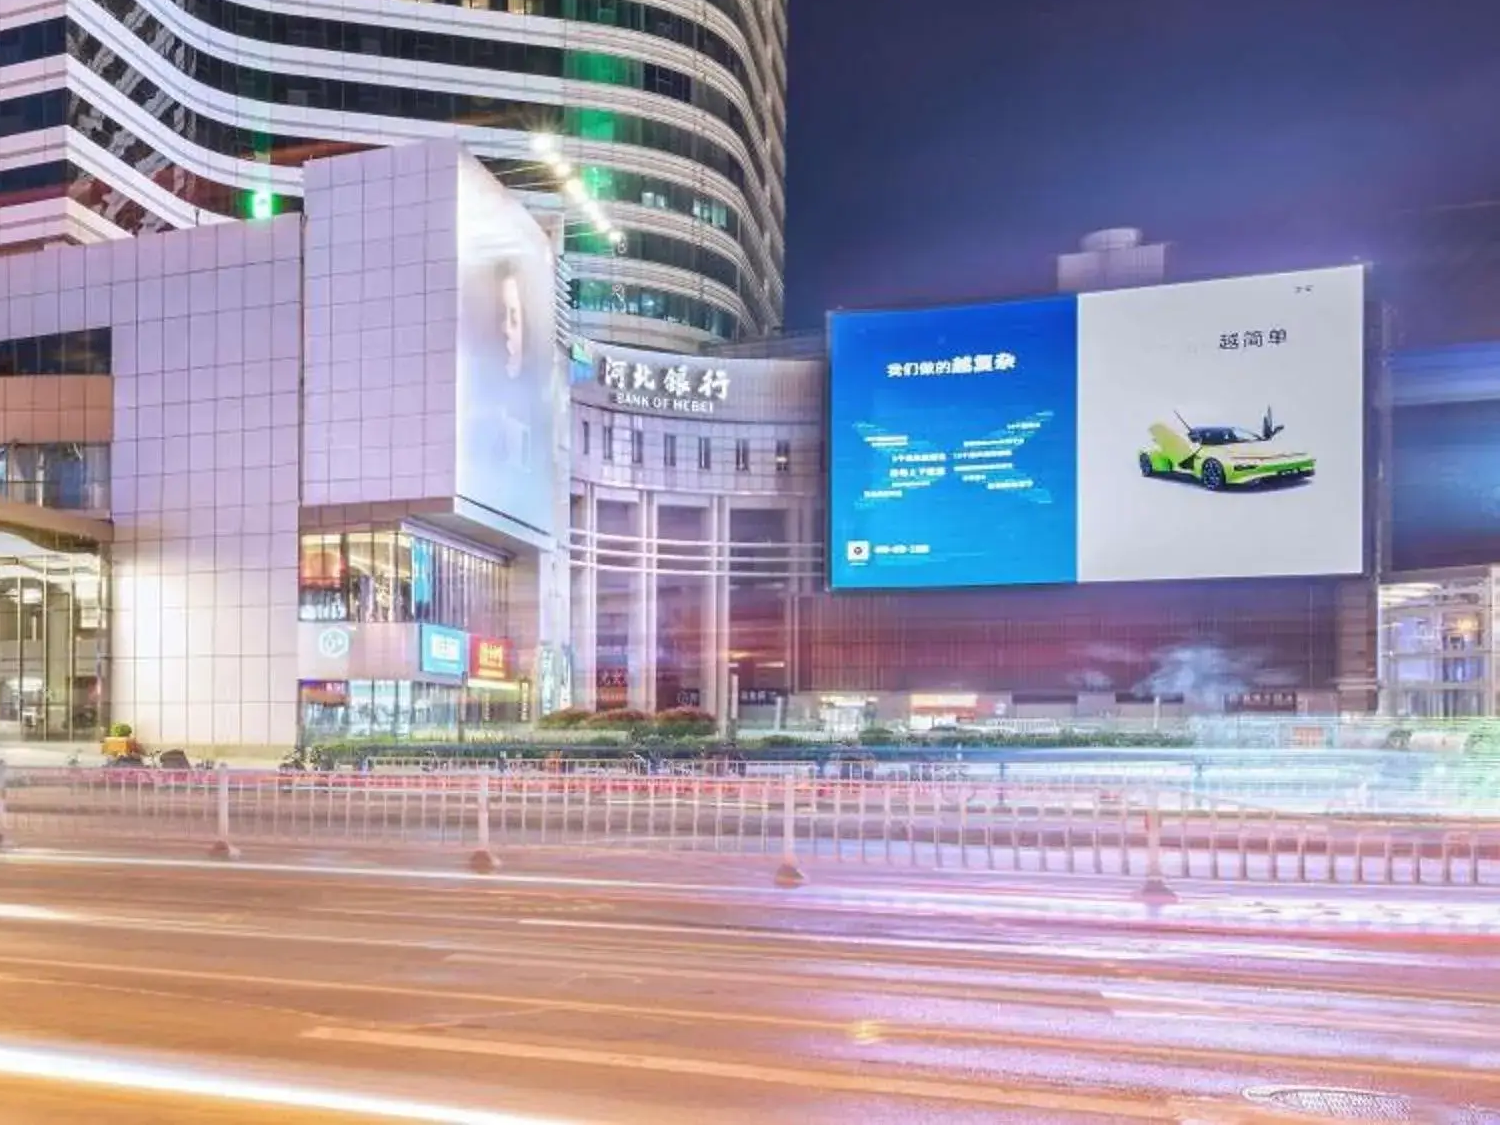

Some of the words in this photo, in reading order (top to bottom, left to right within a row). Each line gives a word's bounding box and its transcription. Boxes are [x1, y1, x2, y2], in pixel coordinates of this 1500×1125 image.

[1219, 328, 1287, 350] 越简单
[605, 356, 731, 400] 河北银行
[616, 392, 651, 408] BANK
[653, 396, 670, 409] OF
[673, 398, 714, 413] HEBEI
